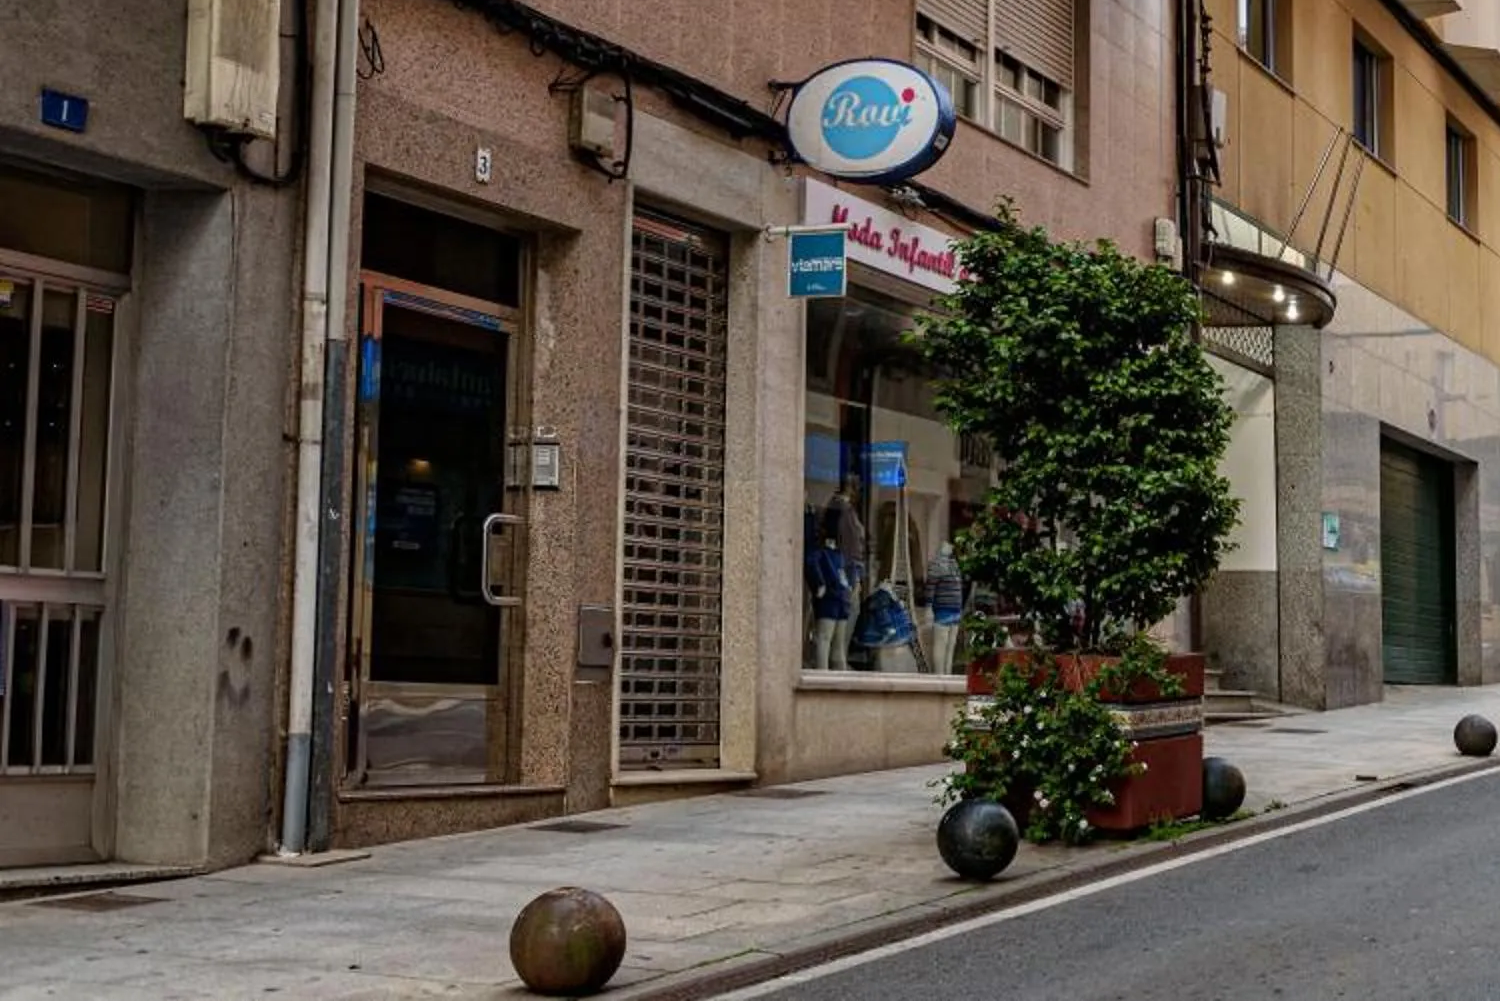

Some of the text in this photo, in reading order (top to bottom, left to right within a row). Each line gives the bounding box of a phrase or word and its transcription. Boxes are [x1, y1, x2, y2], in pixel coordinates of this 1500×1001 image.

[823, 87, 915, 128] Rovi
[479, 156, 488, 175] 3
[887, 227, 957, 280] Infantil
